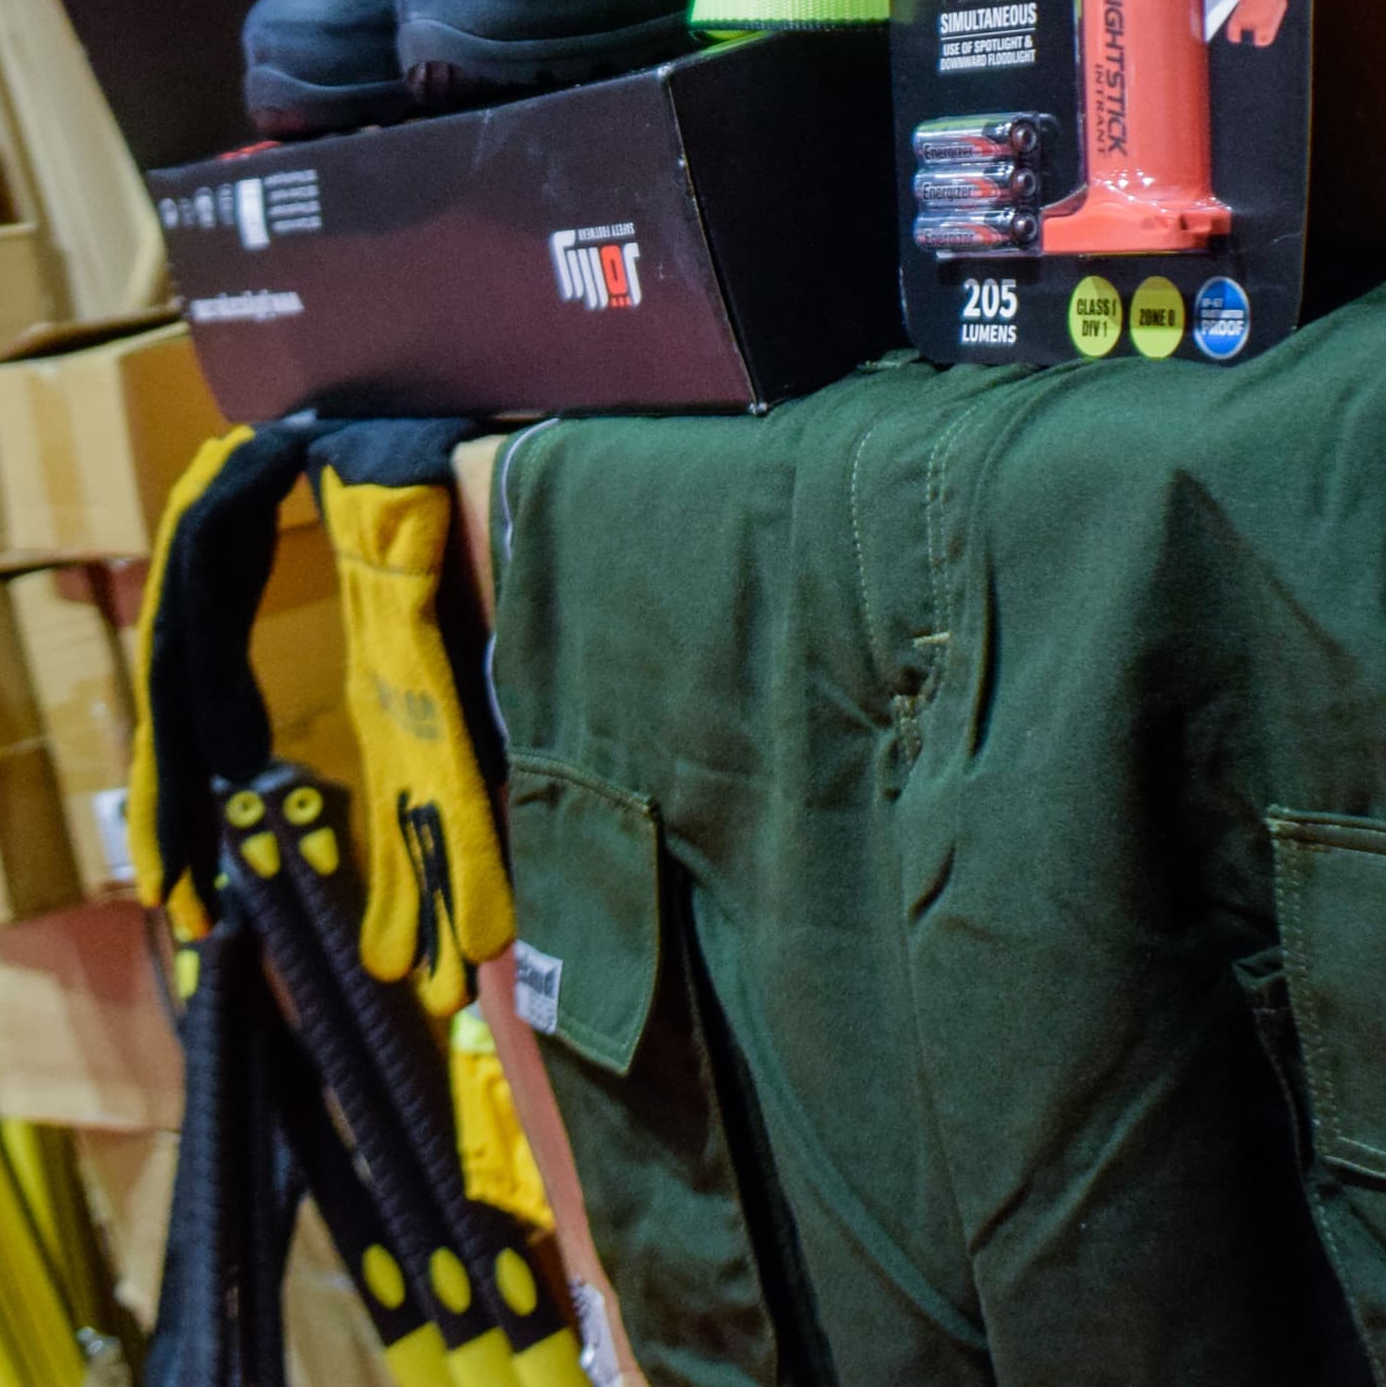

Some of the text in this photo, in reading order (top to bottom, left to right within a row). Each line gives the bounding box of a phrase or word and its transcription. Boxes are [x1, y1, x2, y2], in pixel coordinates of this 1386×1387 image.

[940, 2, 1038, 34] SIMULTANEOUS
[943, 34, 1033, 57] USE OF SPOTLIGHT &
[940, 48, 1037, 71] DOWNWARD FLOODLIGHT
[1095, 63, 1107, 157] INTRANT
[923, 182, 973, 202] Energizer
[610, 222, 635, 237] SAFETY
[963, 278, 1018, 319] 205
[1076, 298, 1110, 317] CLASS
[1139, 308, 1166, 327] ZONE
[1201, 319, 1245, 336] PROOF
[962, 324, 1018, 345] LUMENS
[1081, 319, 1100, 338] DIV
